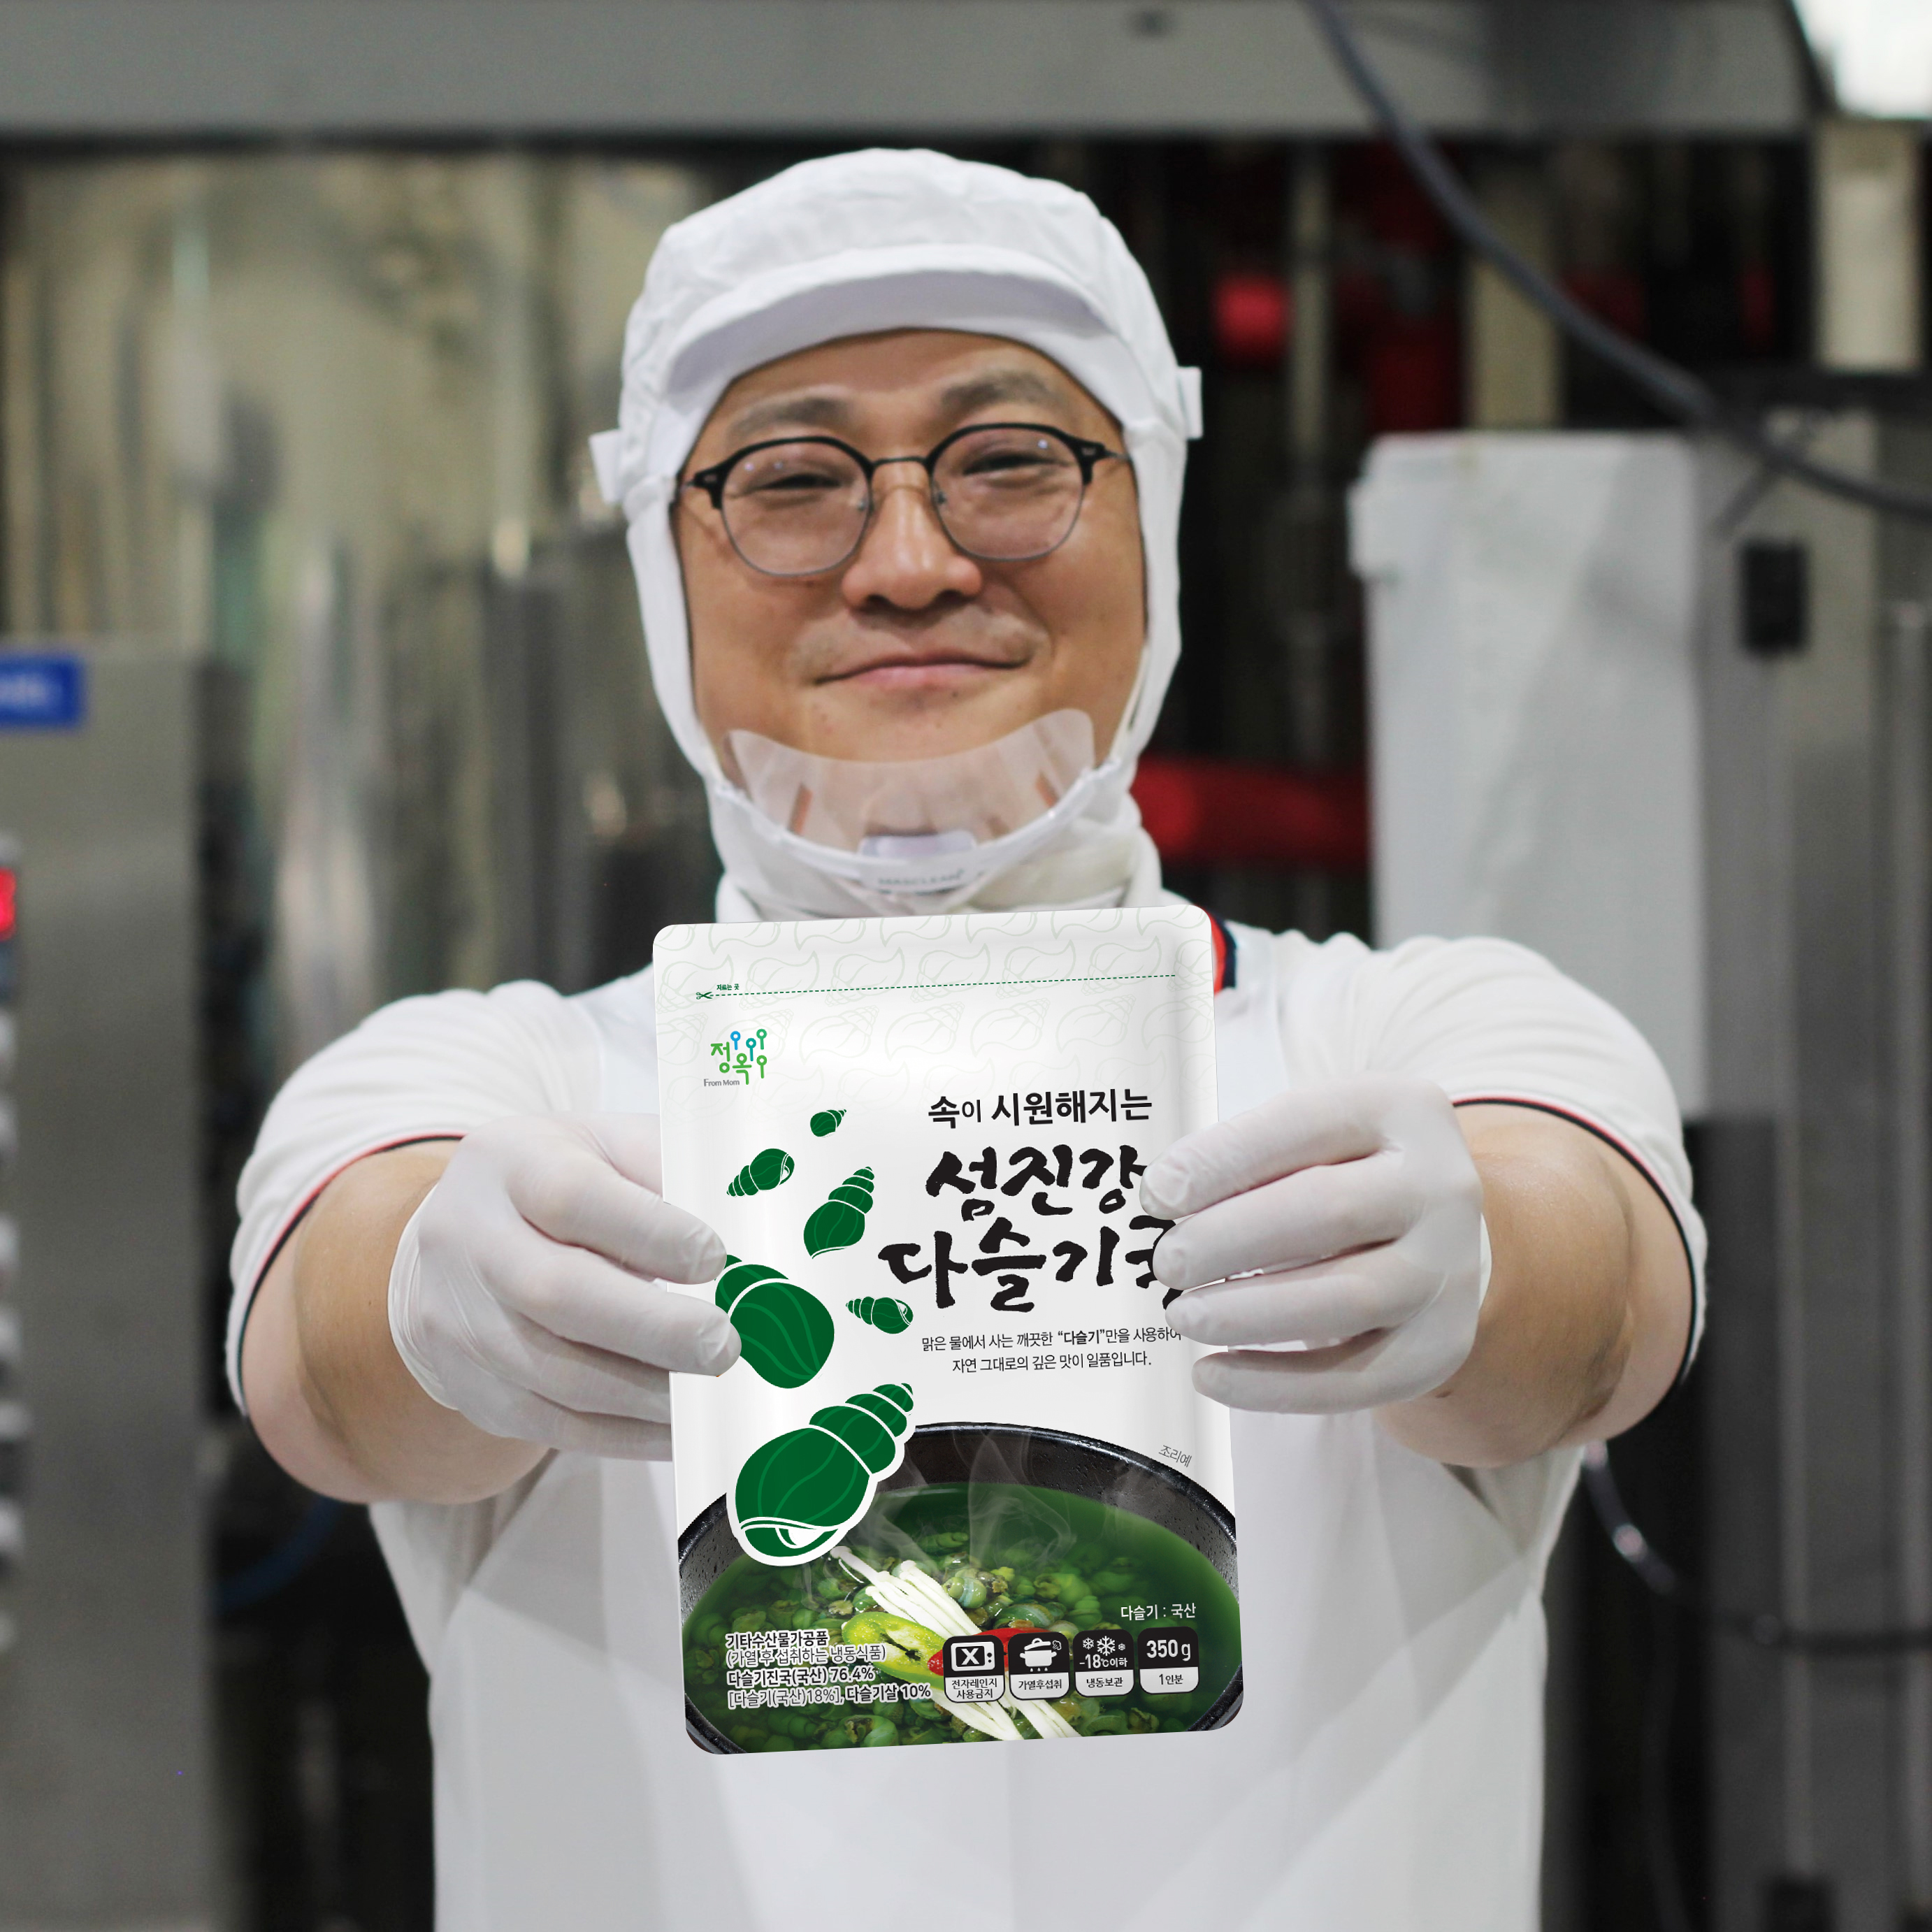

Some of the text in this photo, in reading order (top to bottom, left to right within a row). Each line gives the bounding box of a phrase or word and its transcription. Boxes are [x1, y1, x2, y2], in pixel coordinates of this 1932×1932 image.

[928, 1089, 1152, 1129] 속이 시원해지는
[924, 1142, 1146, 1222] 섬진강
[922, 1336, 946, 1351] 맑은
[949, 1334, 985, 1350] 물에서
[989, 1334, 1014, 1348] 사는
[1017, 1332, 1053, 1347] 깨끗한
[953, 1350, 1151, 1373] 자연 그대로의 깊은 맛이 일품입니다.
[1158, 1444, 1192, 1468] 조리예
[1121, 1605, 1158, 1620] 다슬기
[1172, 1603, 1196, 1618] 국산
[727, 1630, 828, 1648] 기타수산물가공품
[776, 1647, 828, 1664] 섭취하는
[831, 1645, 886, 1662] 냉동식품)
[728, 1666, 874, 1687] 다슬기진국(국산) 76.4%
[951, 1678, 997, 1689] 전자레인지
[1019, 1680, 1061, 1689] 가열후섭취
[1087, 1678, 1123, 1688] 냉동보관
[1160, 1674, 1183, 1685] 1인분
[847, 1685, 897, 1701] 다슬기살
[902, 1684, 931, 1699] 10%
[956, 1688, 993, 1699] 사용금지
